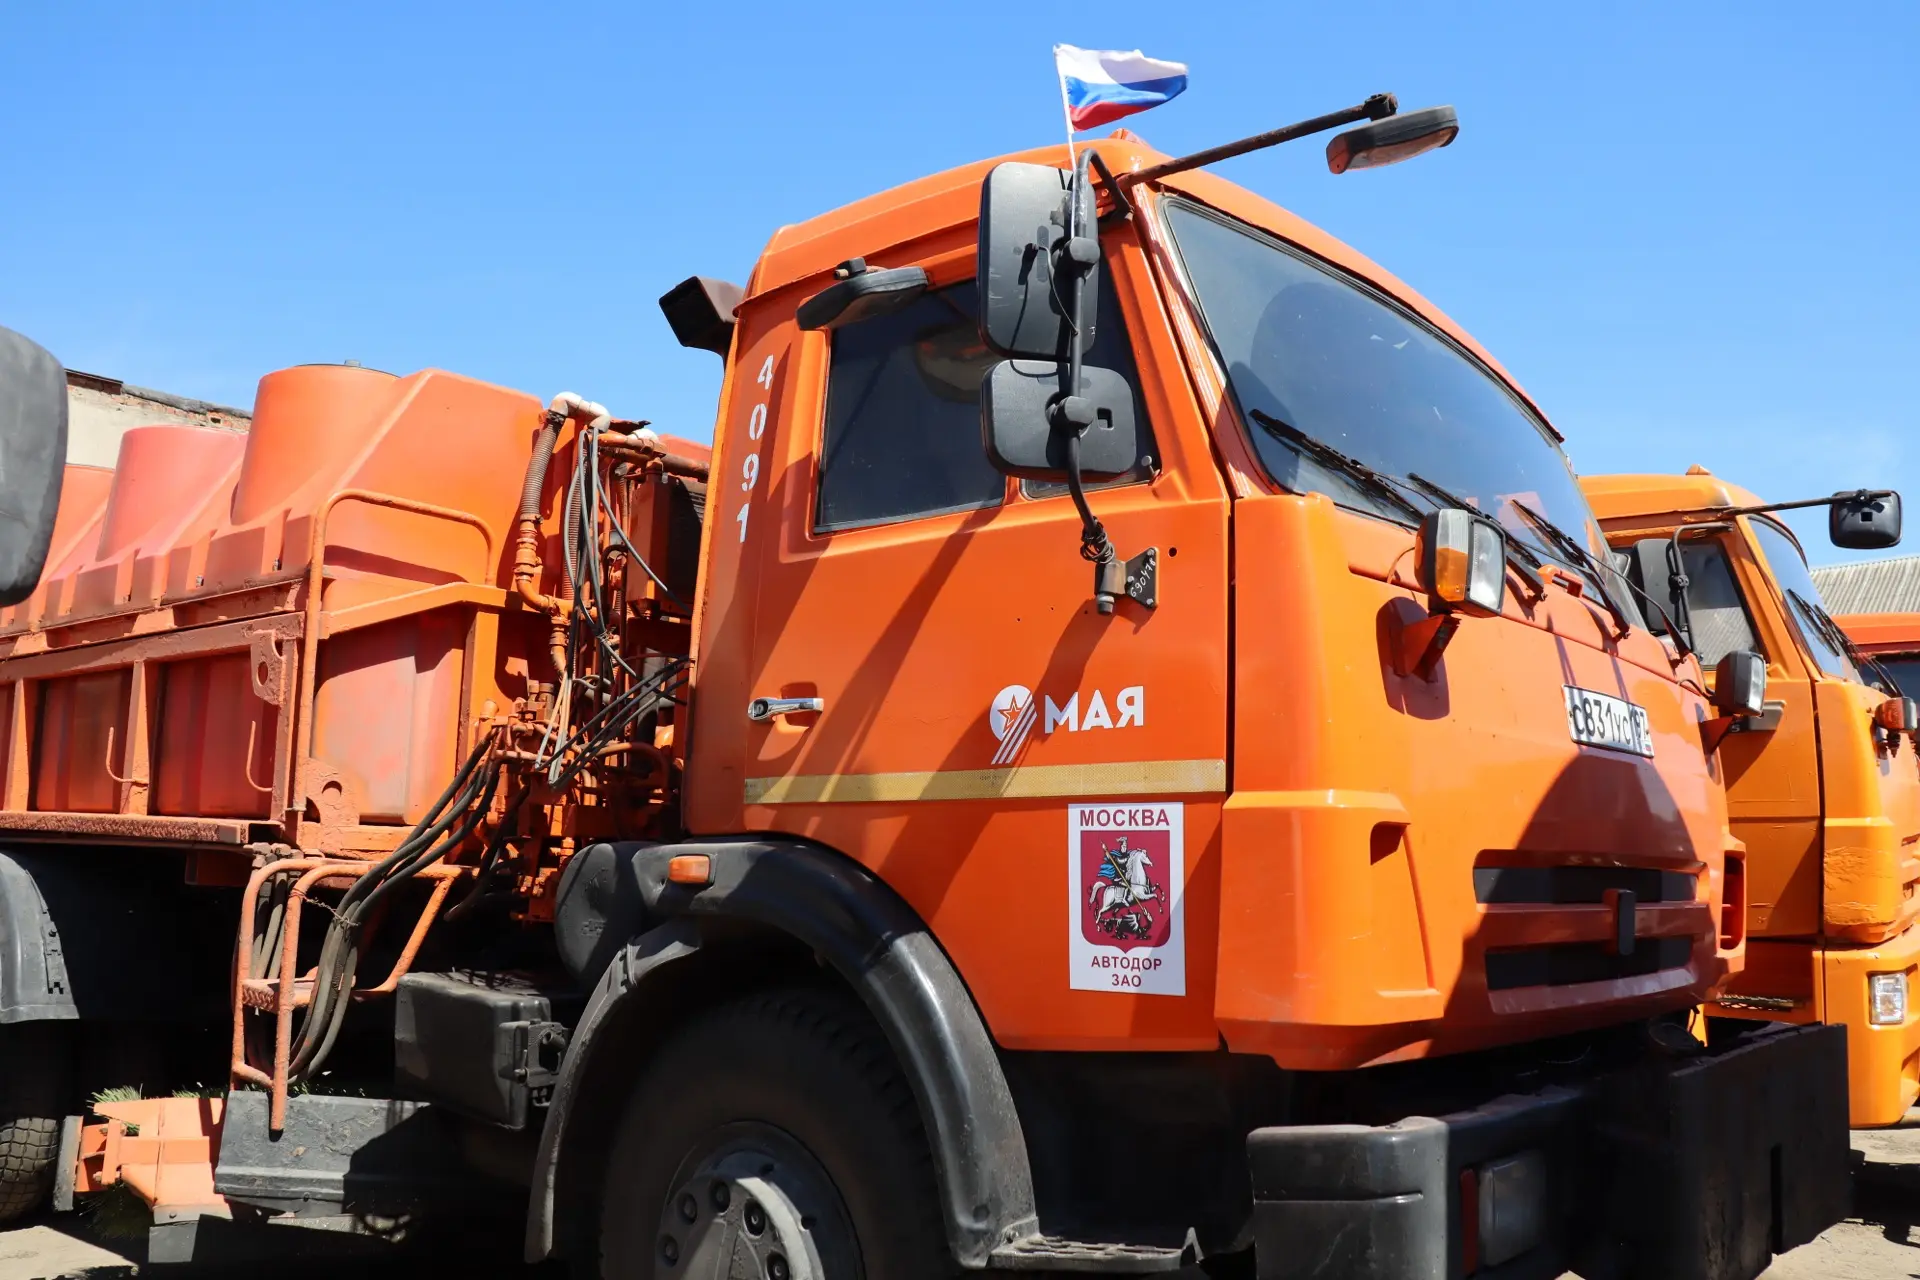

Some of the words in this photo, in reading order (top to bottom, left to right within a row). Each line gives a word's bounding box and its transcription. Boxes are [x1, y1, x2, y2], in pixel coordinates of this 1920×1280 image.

[736, 354, 774, 543] 4091
[1044, 685, 1144, 734] МАЯ
[1080, 808, 1170, 827] МОСКВА
[1091, 955, 1162, 972] АВТОДОР
[1111, 973, 1142, 987] ЗАО
